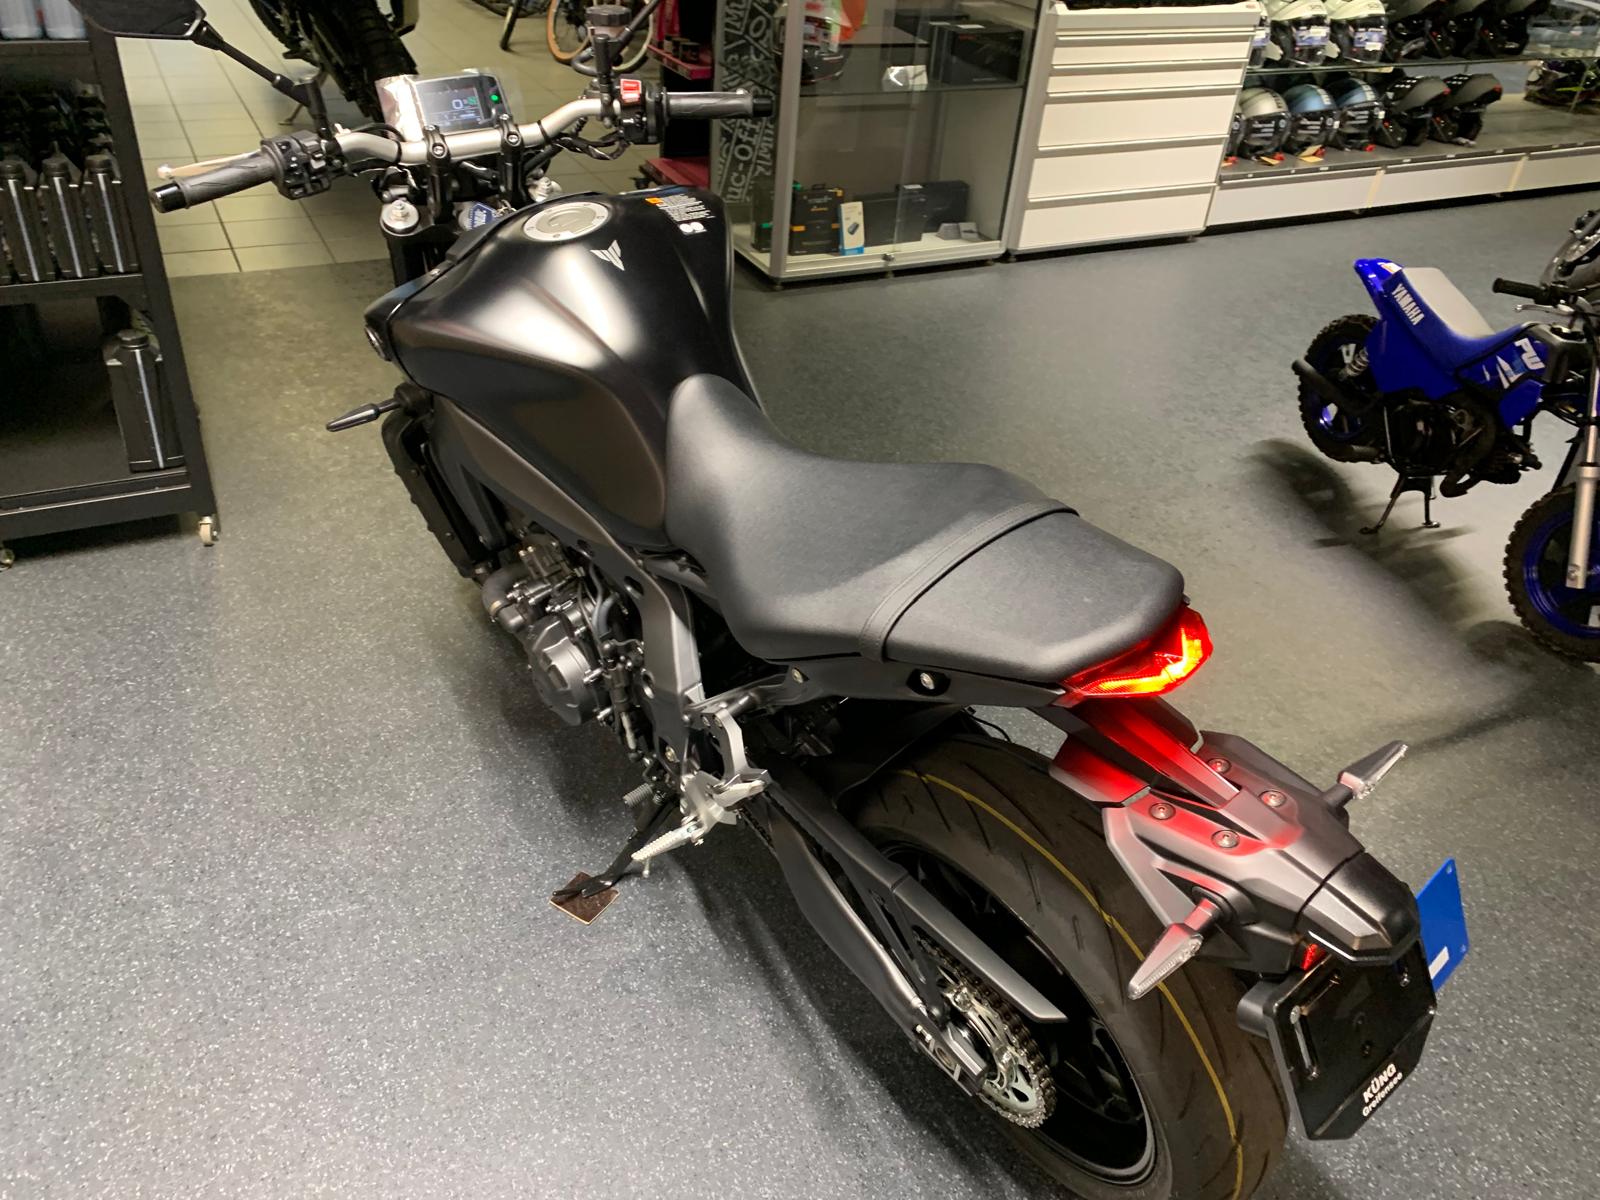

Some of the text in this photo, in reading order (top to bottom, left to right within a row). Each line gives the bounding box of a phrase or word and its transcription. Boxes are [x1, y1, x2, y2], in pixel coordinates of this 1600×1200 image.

[722, 118, 761, 203] uc-Off
[1392, 283, 1425, 326] YAMAHA
[1514, 337, 1546, 370] PW
[1362, 1072, 1403, 1117] Greifensee
[1363, 1063, 1397, 1103] KÜNG
